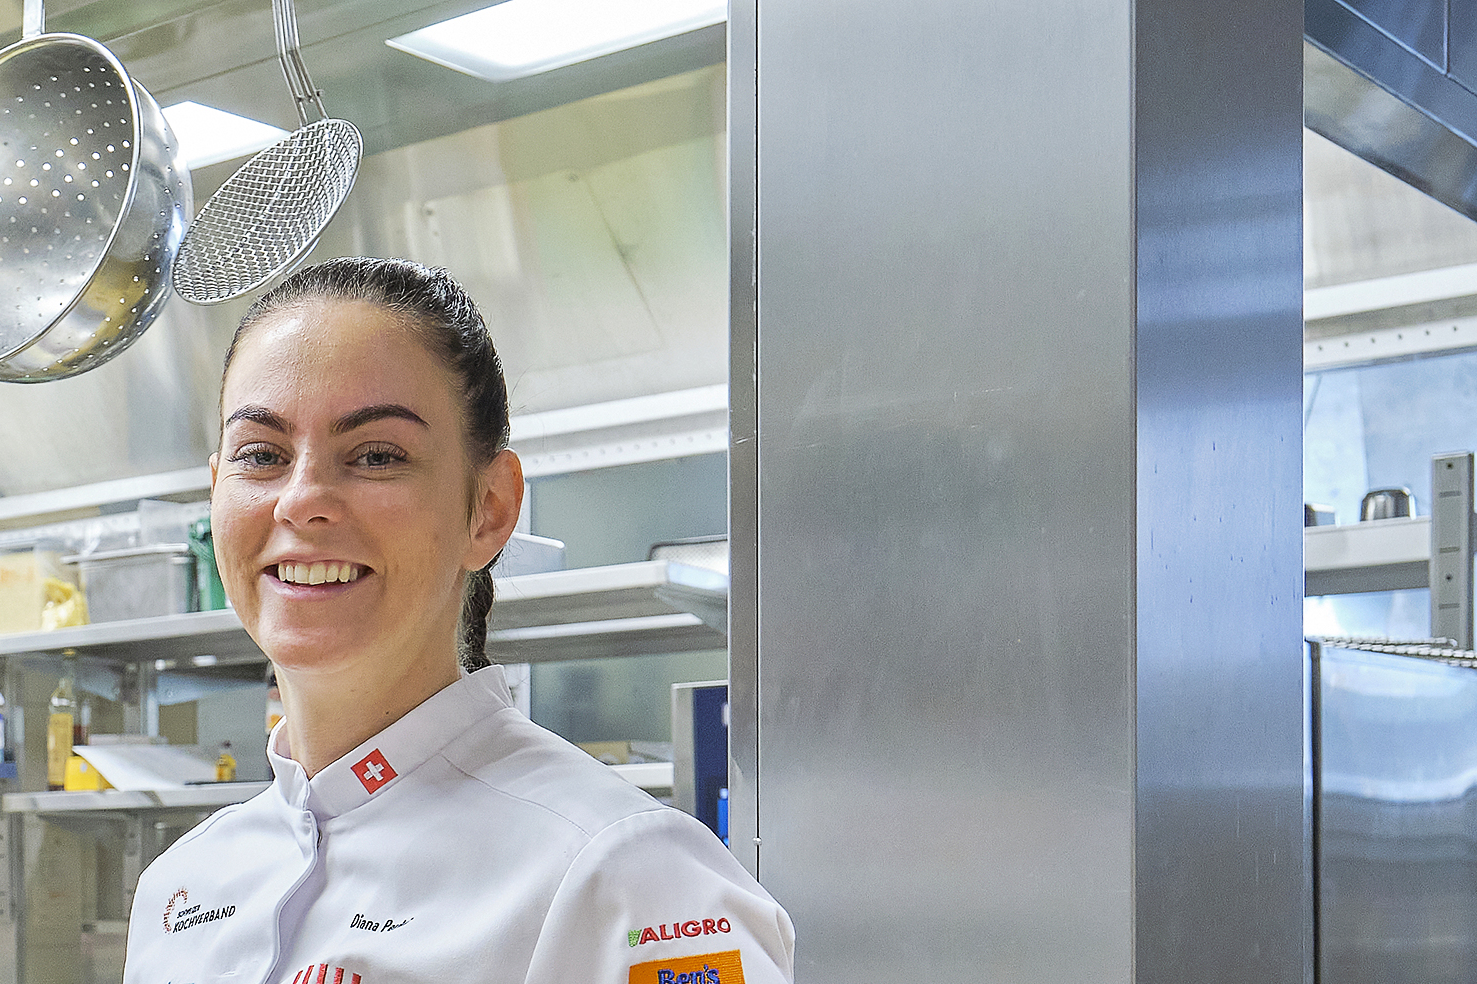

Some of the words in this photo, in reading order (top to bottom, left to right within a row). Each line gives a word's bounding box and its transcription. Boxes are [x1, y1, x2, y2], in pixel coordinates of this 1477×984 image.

[172, 905, 236, 934] KOCHVERBAND
[349, 913, 380, 932] Diana
[638, 917, 732, 945] ALIGRO
